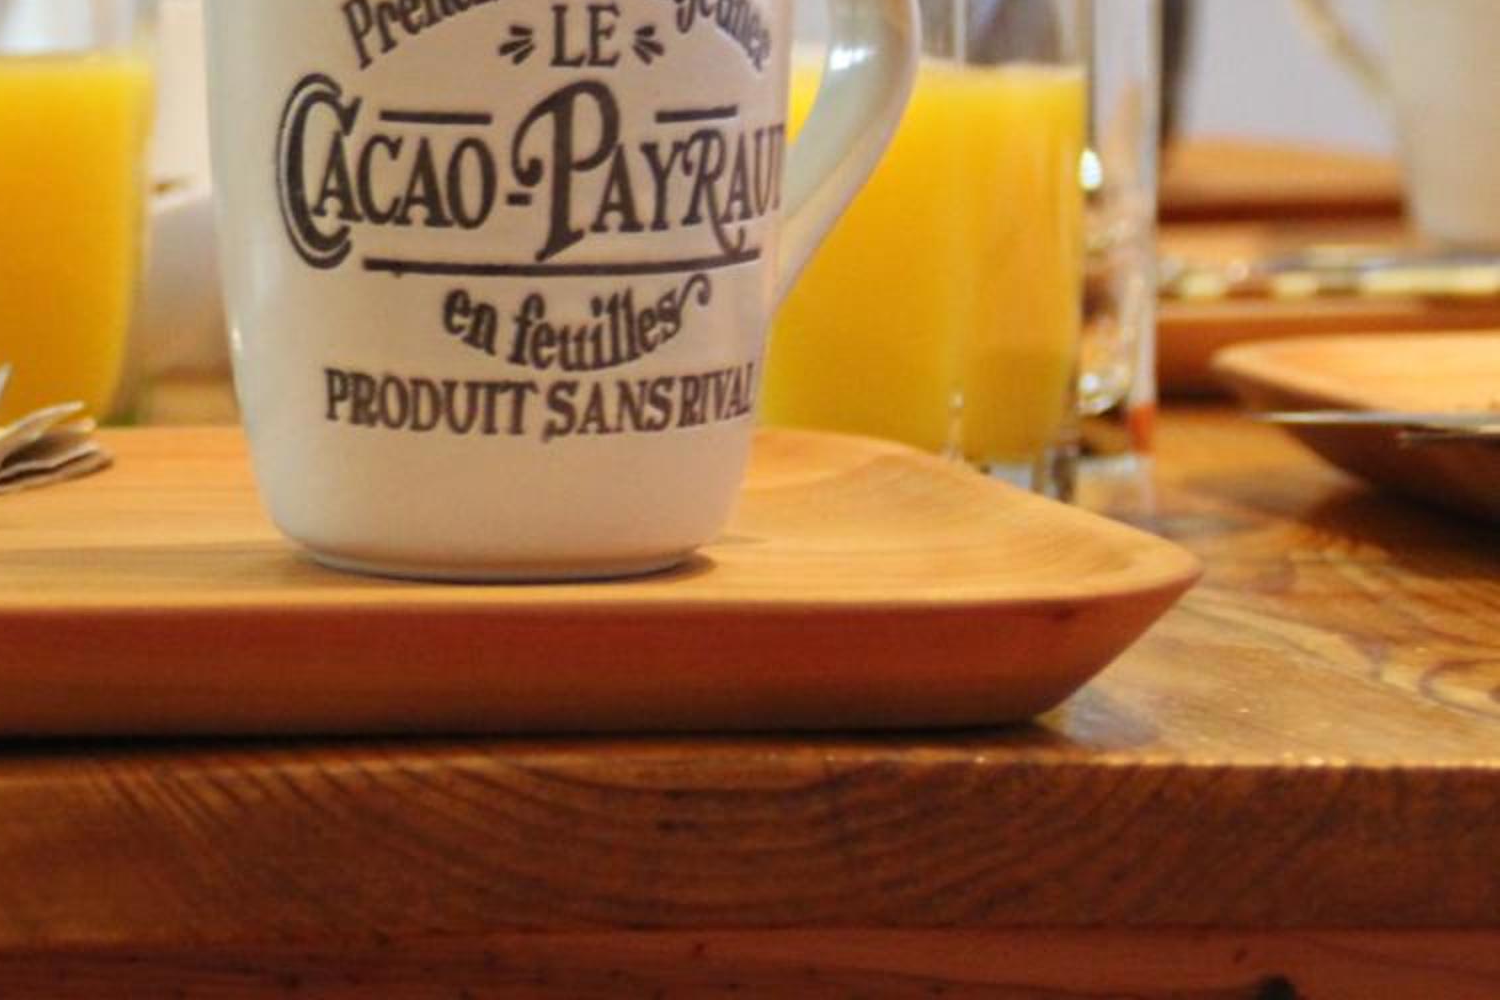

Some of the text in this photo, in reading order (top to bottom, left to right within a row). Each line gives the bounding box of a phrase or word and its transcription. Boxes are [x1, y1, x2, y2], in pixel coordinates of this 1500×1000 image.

[550, 1, 620, 68] LE
[442, 273, 712, 372] en feuilles
[325, 367, 540, 436] PRODUIT
[541, 374, 674, 442] SANS
